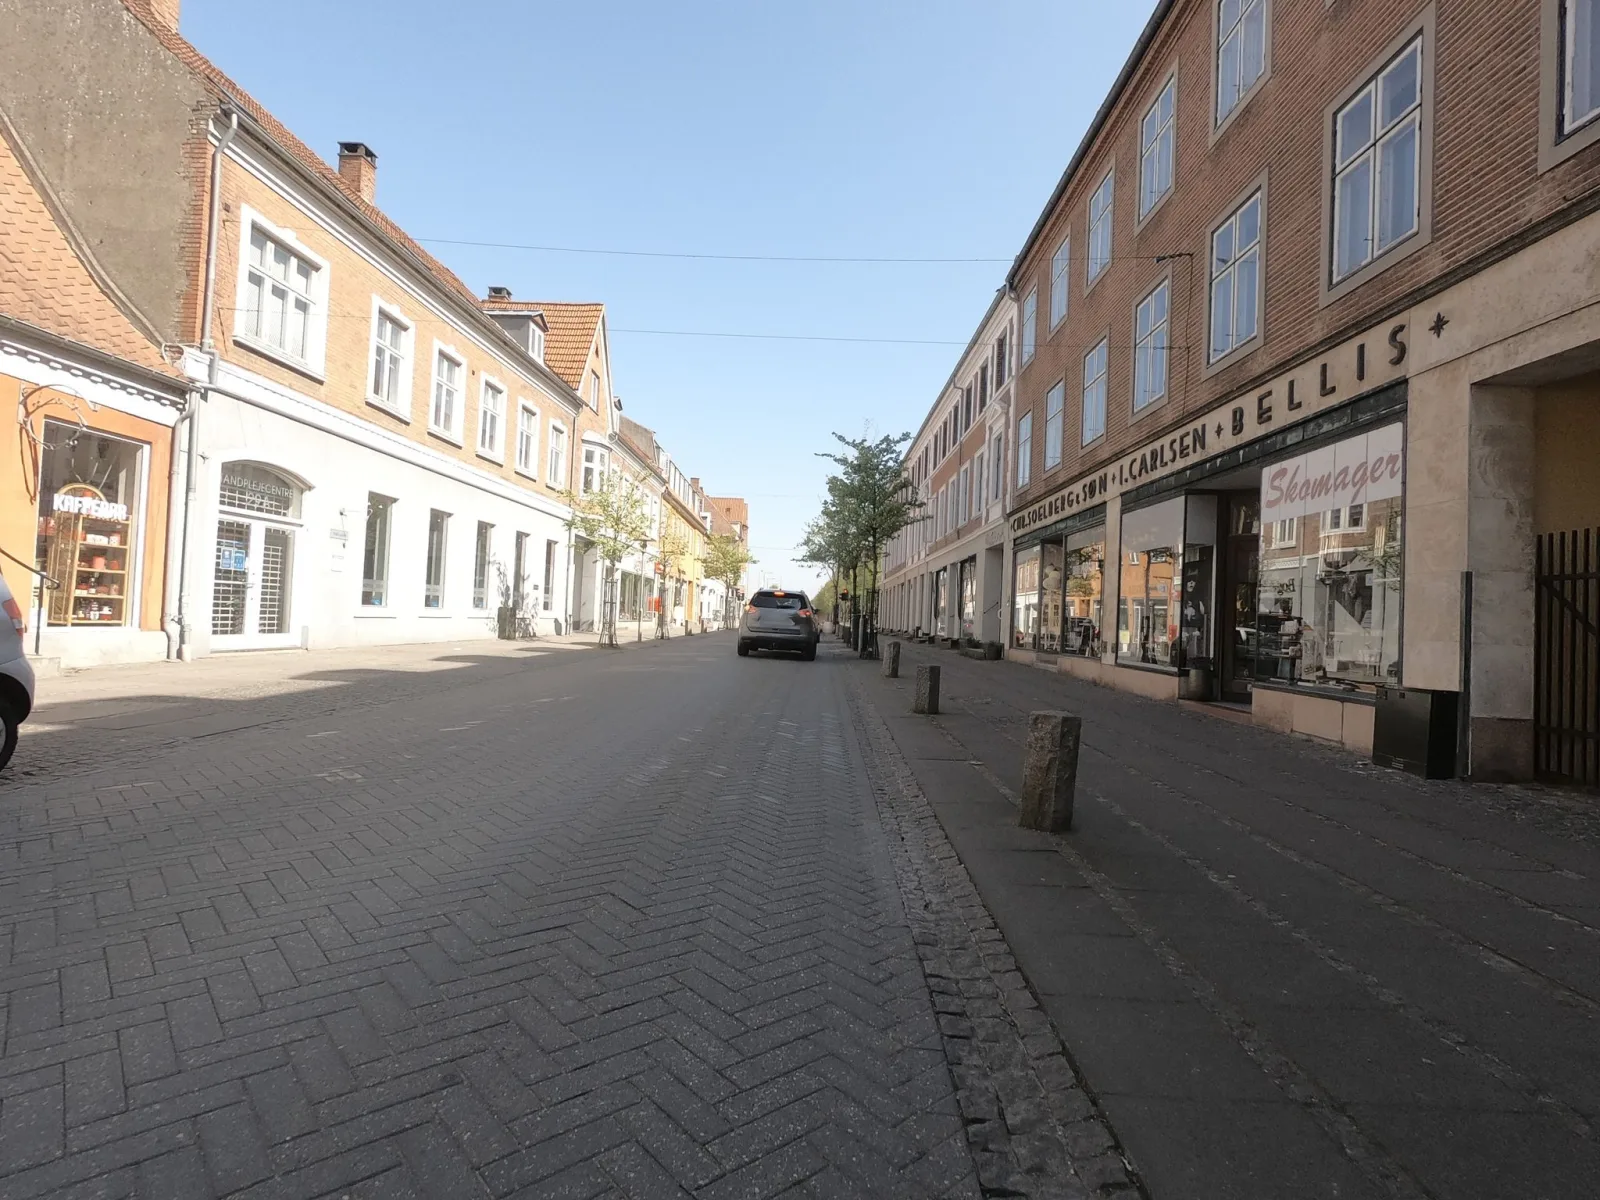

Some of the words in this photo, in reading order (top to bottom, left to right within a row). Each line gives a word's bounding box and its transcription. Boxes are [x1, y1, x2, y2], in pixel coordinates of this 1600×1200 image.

[1082, 472, 1108, 502] SØN
[1231, 323, 1407, 436] BELLIS
[1265, 452, 1401, 509] Skomager
